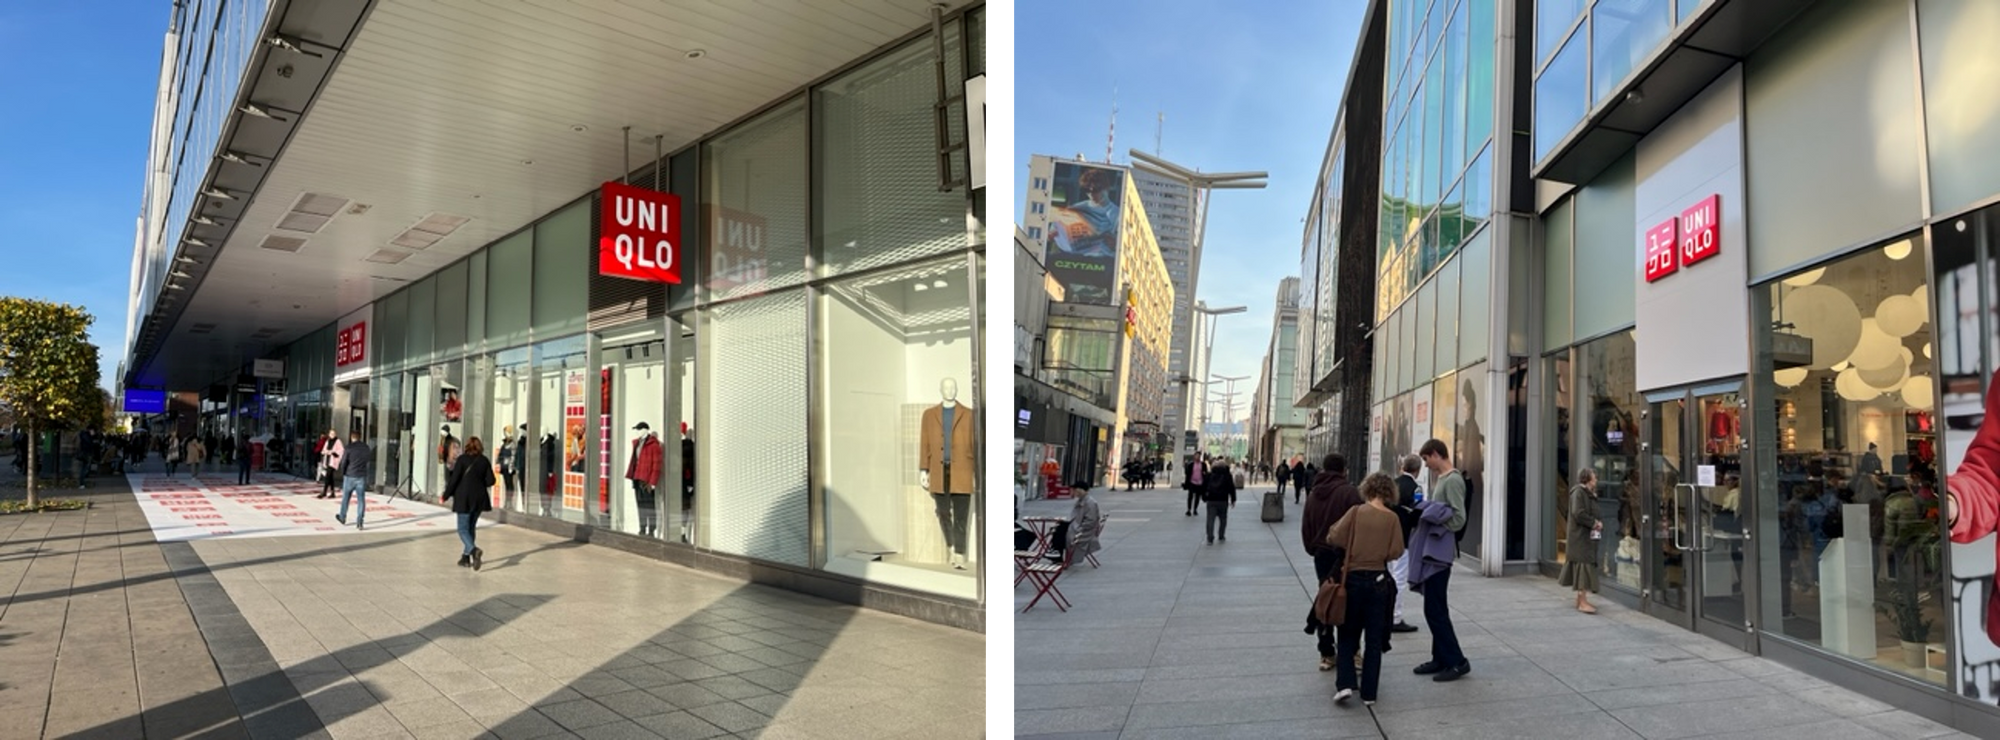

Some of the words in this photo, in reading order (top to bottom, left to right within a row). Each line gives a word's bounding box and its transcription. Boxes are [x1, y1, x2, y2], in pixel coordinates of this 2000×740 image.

[616, 195, 668, 234] UNI
[1685, 205, 1710, 234] UNI
[615, 234, 673, 270] QLO
[1685, 228, 1712, 259] QLO
[1055, 260, 1106, 272] CZYTAM
